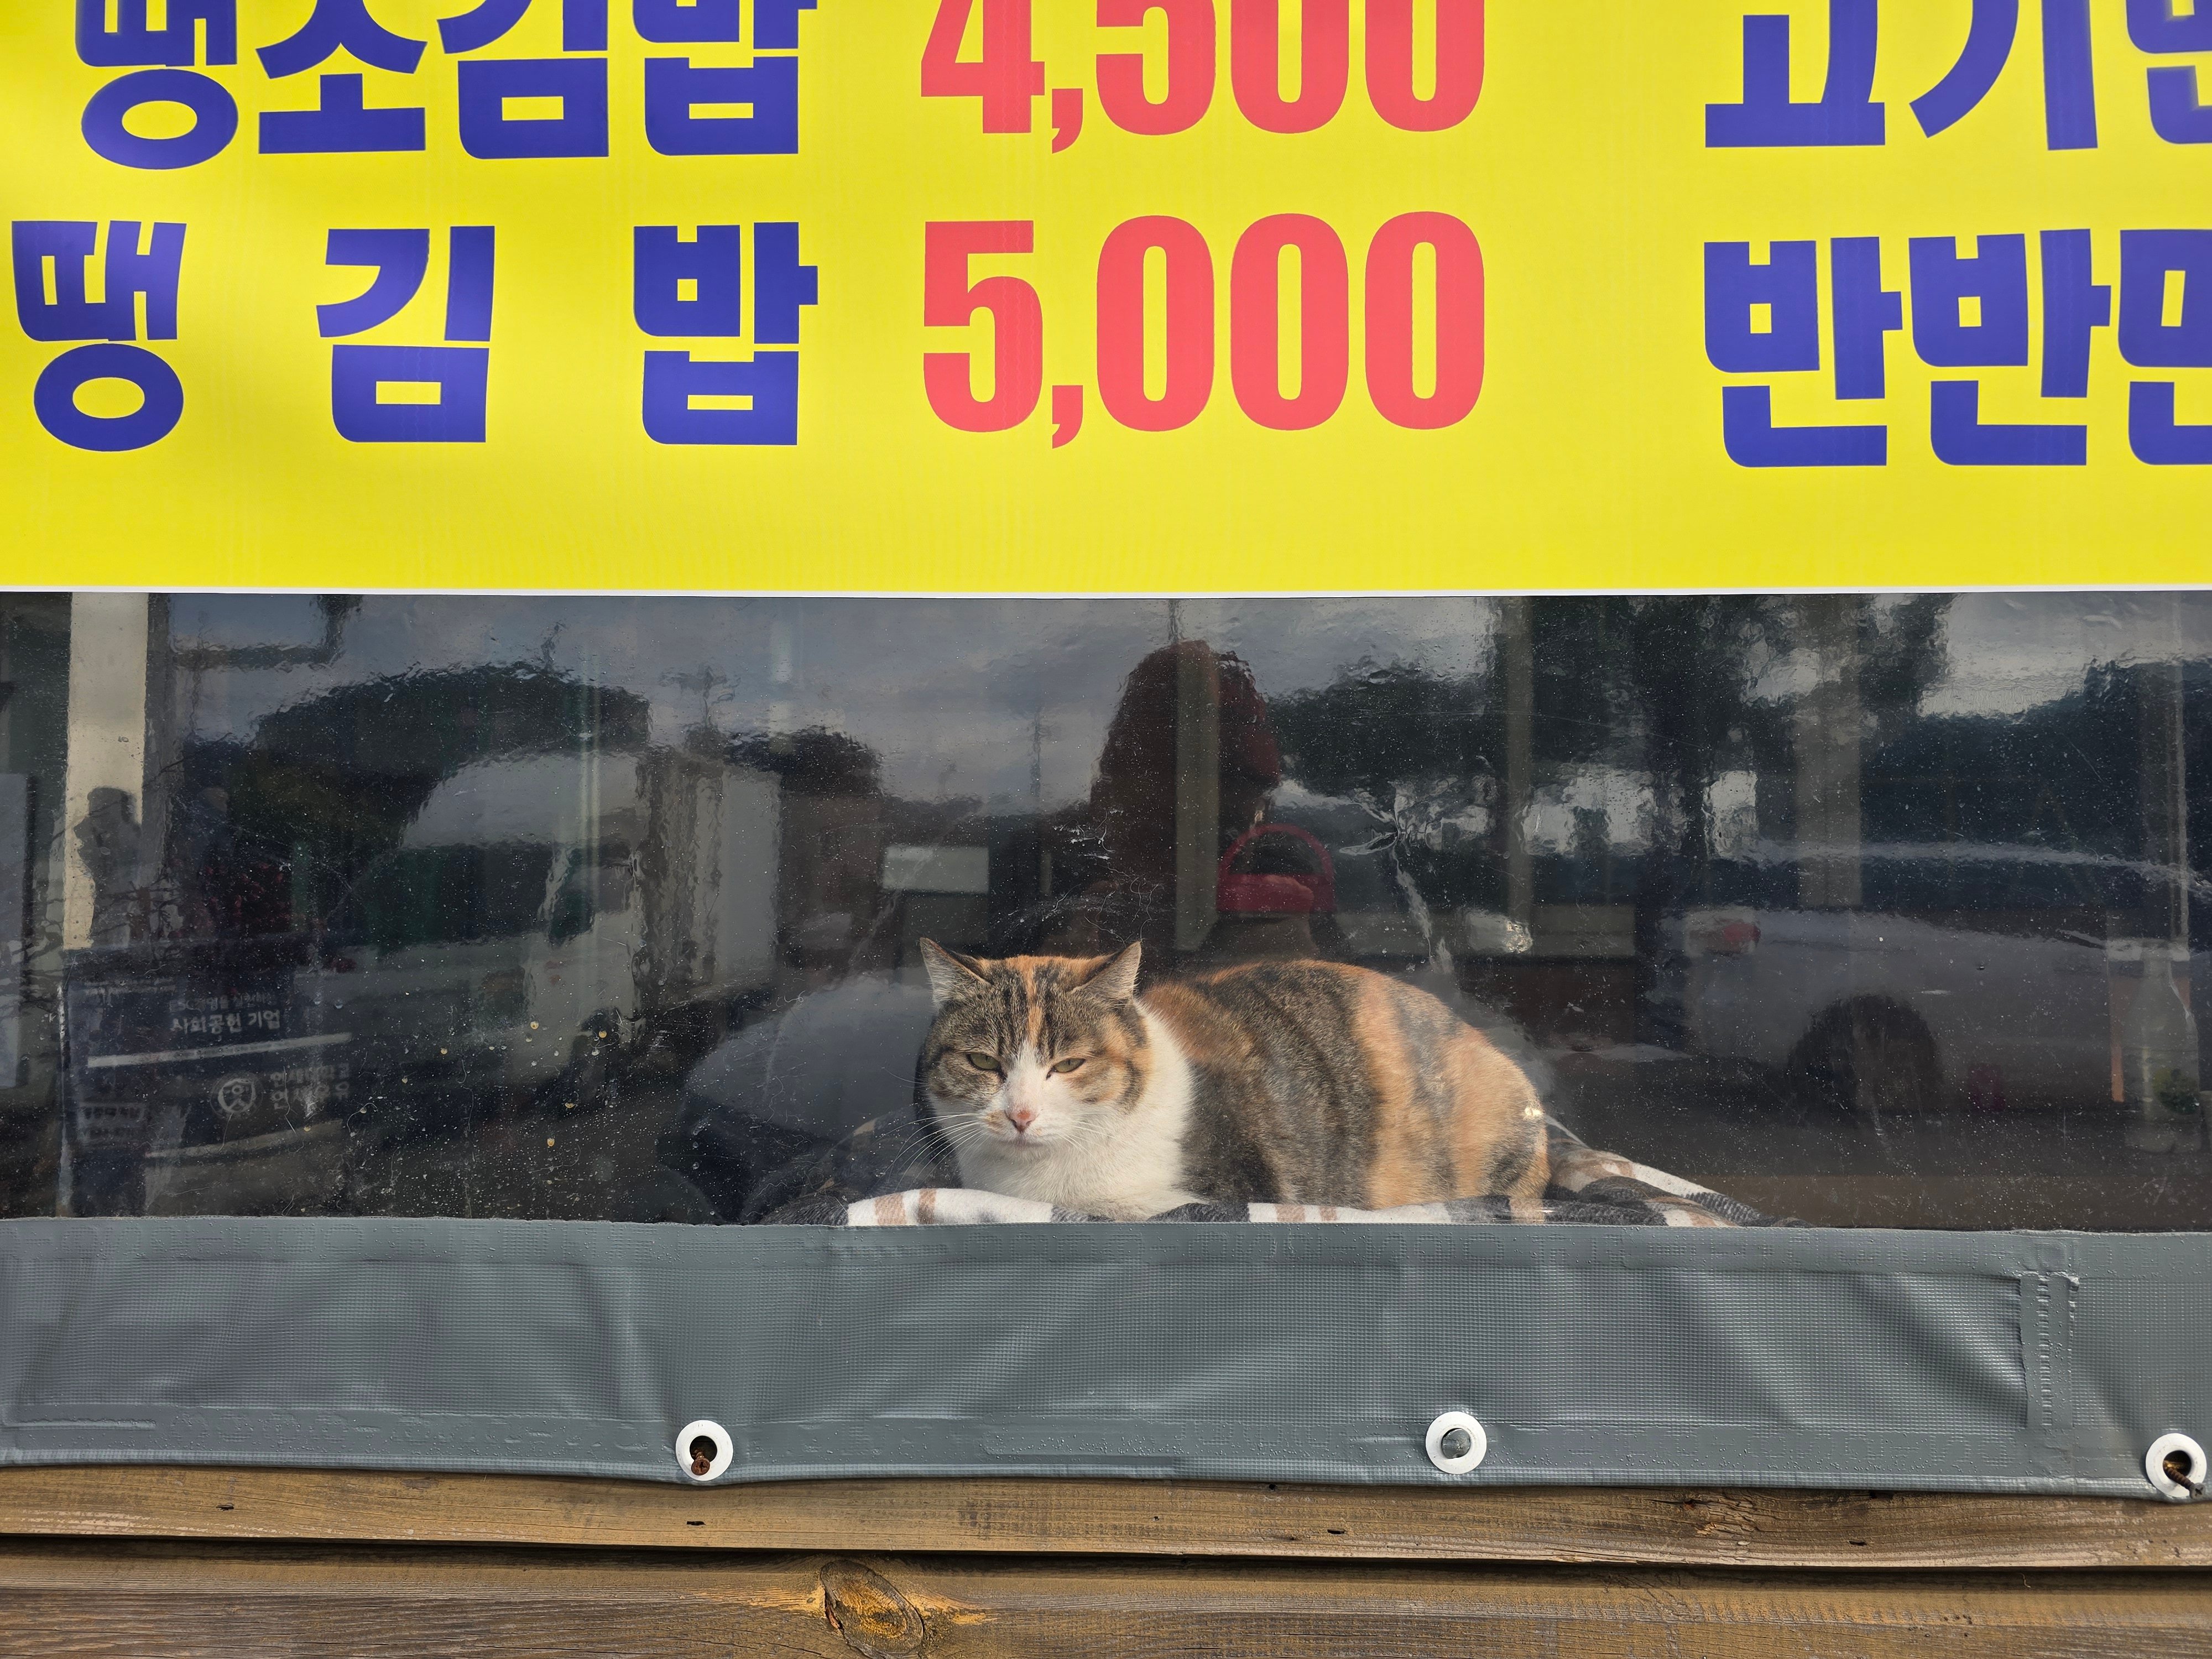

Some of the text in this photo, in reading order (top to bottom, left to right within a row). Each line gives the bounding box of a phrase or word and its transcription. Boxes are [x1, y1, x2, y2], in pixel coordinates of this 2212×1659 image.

[921, 0, 1485, 154] 4,500
[923, 211, 1485, 449] 5,000
[170, 1009, 280, 1035] 사회공헌 기업
